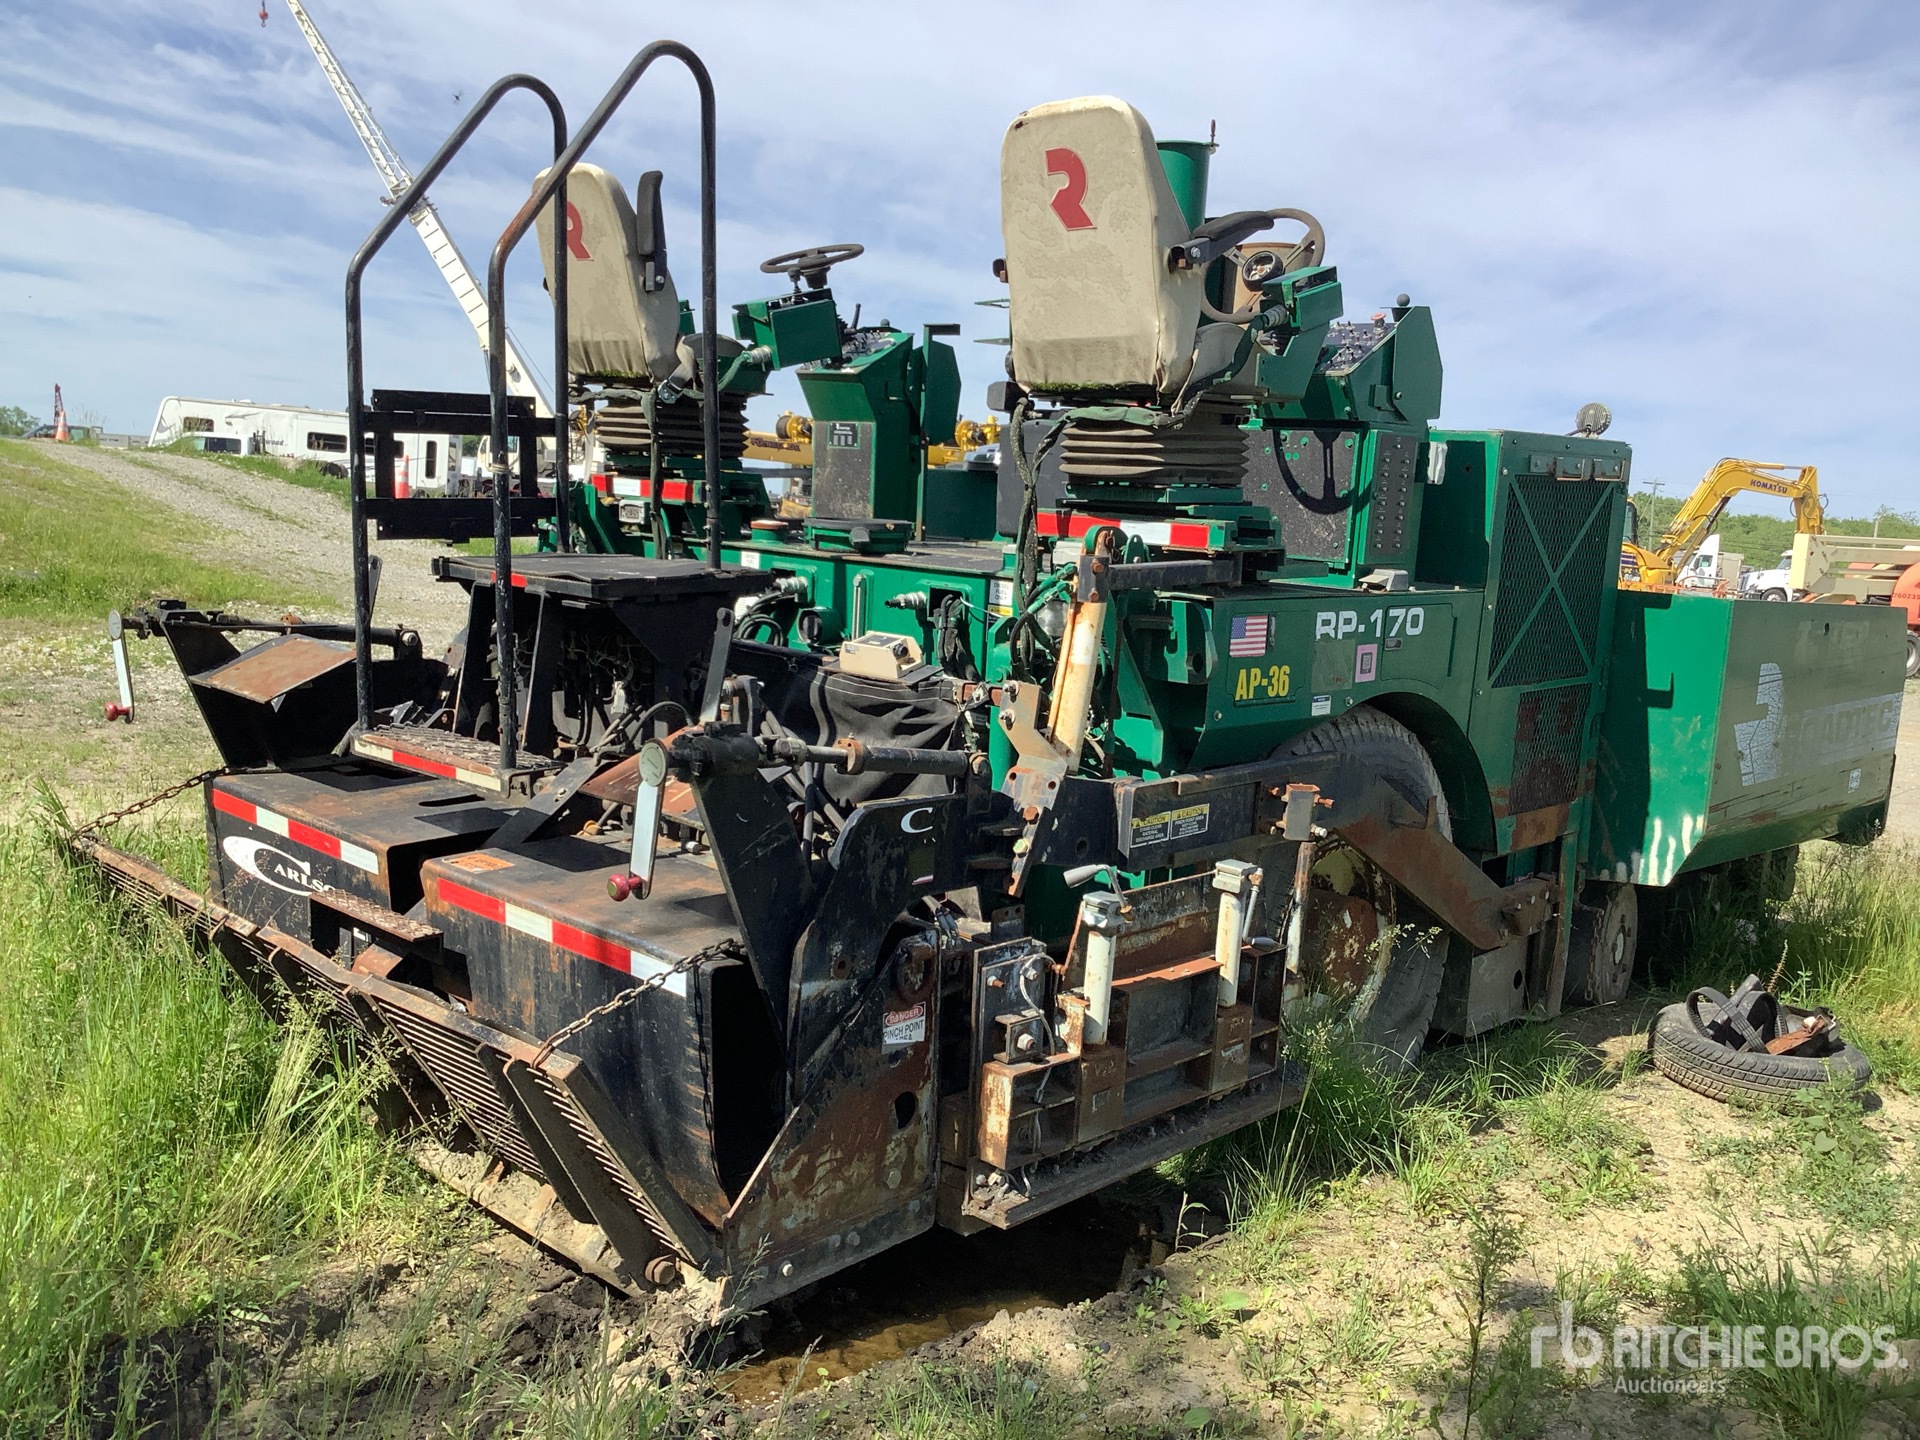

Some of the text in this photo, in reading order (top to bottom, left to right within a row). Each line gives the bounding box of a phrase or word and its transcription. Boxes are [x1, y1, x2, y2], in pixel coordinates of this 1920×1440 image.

[1750, 479, 1788, 494] KOMATSU
[1315, 607, 1425, 641] RP-170
[1235, 665, 1291, 702] AP-36
[1181, 807, 1205, 818] CAUTION
[1144, 816, 1166, 825] CAUTION
[889, 1008, 918, 1023] DANGER
[883, 1019, 924, 1040] PINCH POINT
